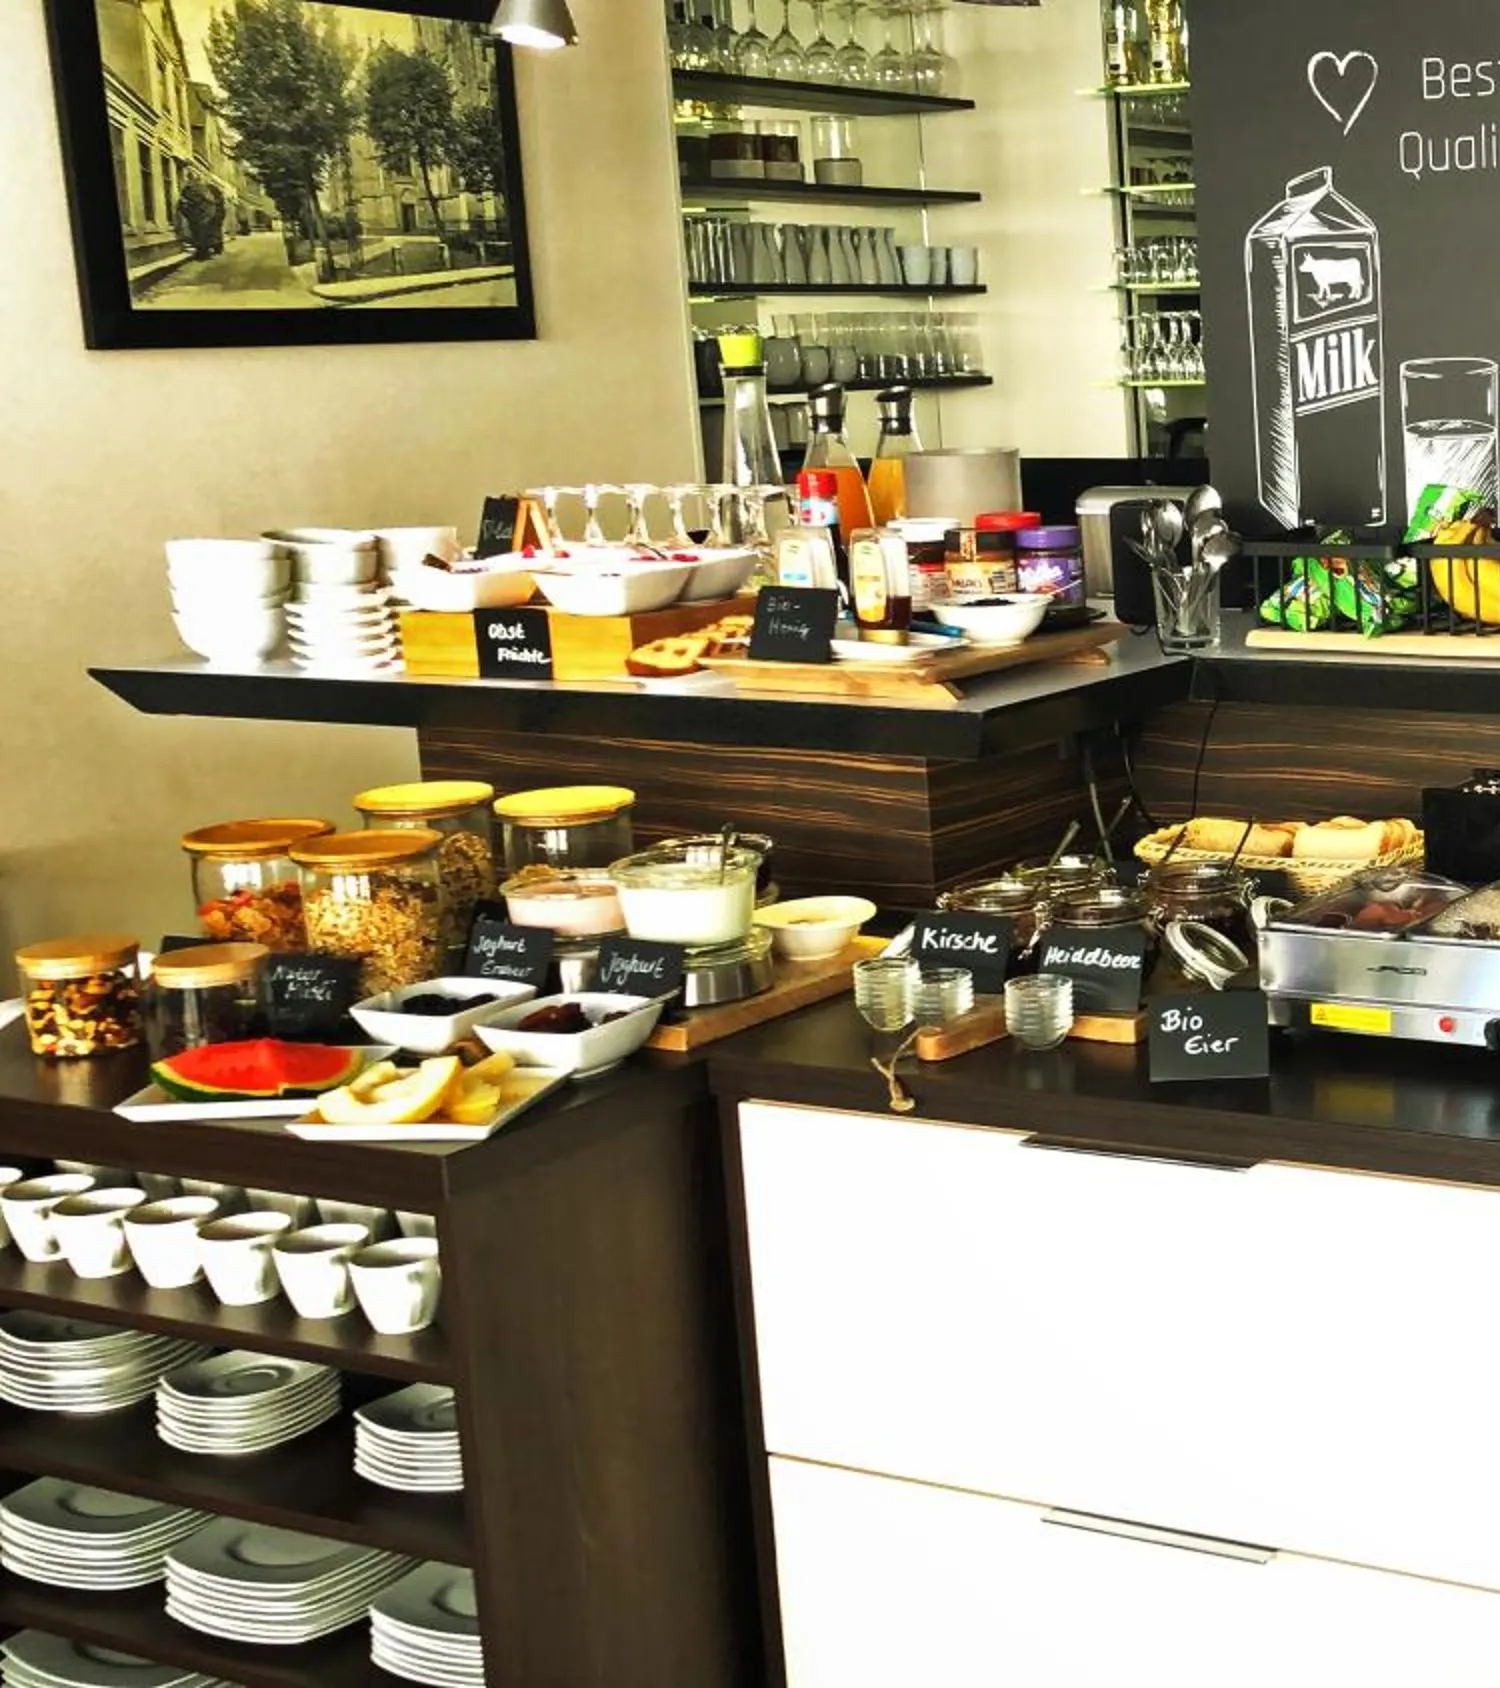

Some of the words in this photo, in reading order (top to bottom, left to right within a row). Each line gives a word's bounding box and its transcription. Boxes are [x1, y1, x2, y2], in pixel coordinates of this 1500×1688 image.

[1295, 327, 1380, 403] Milk
[487, 622, 526, 640] Obst
[473, 935, 527, 957] Joghurt
[921, 926, 999, 954] Kirsche
[600, 951, 665, 987] Joghurt
[1160, 1005, 1203, 1032] Bio
[1184, 1033, 1240, 1055] Eier
